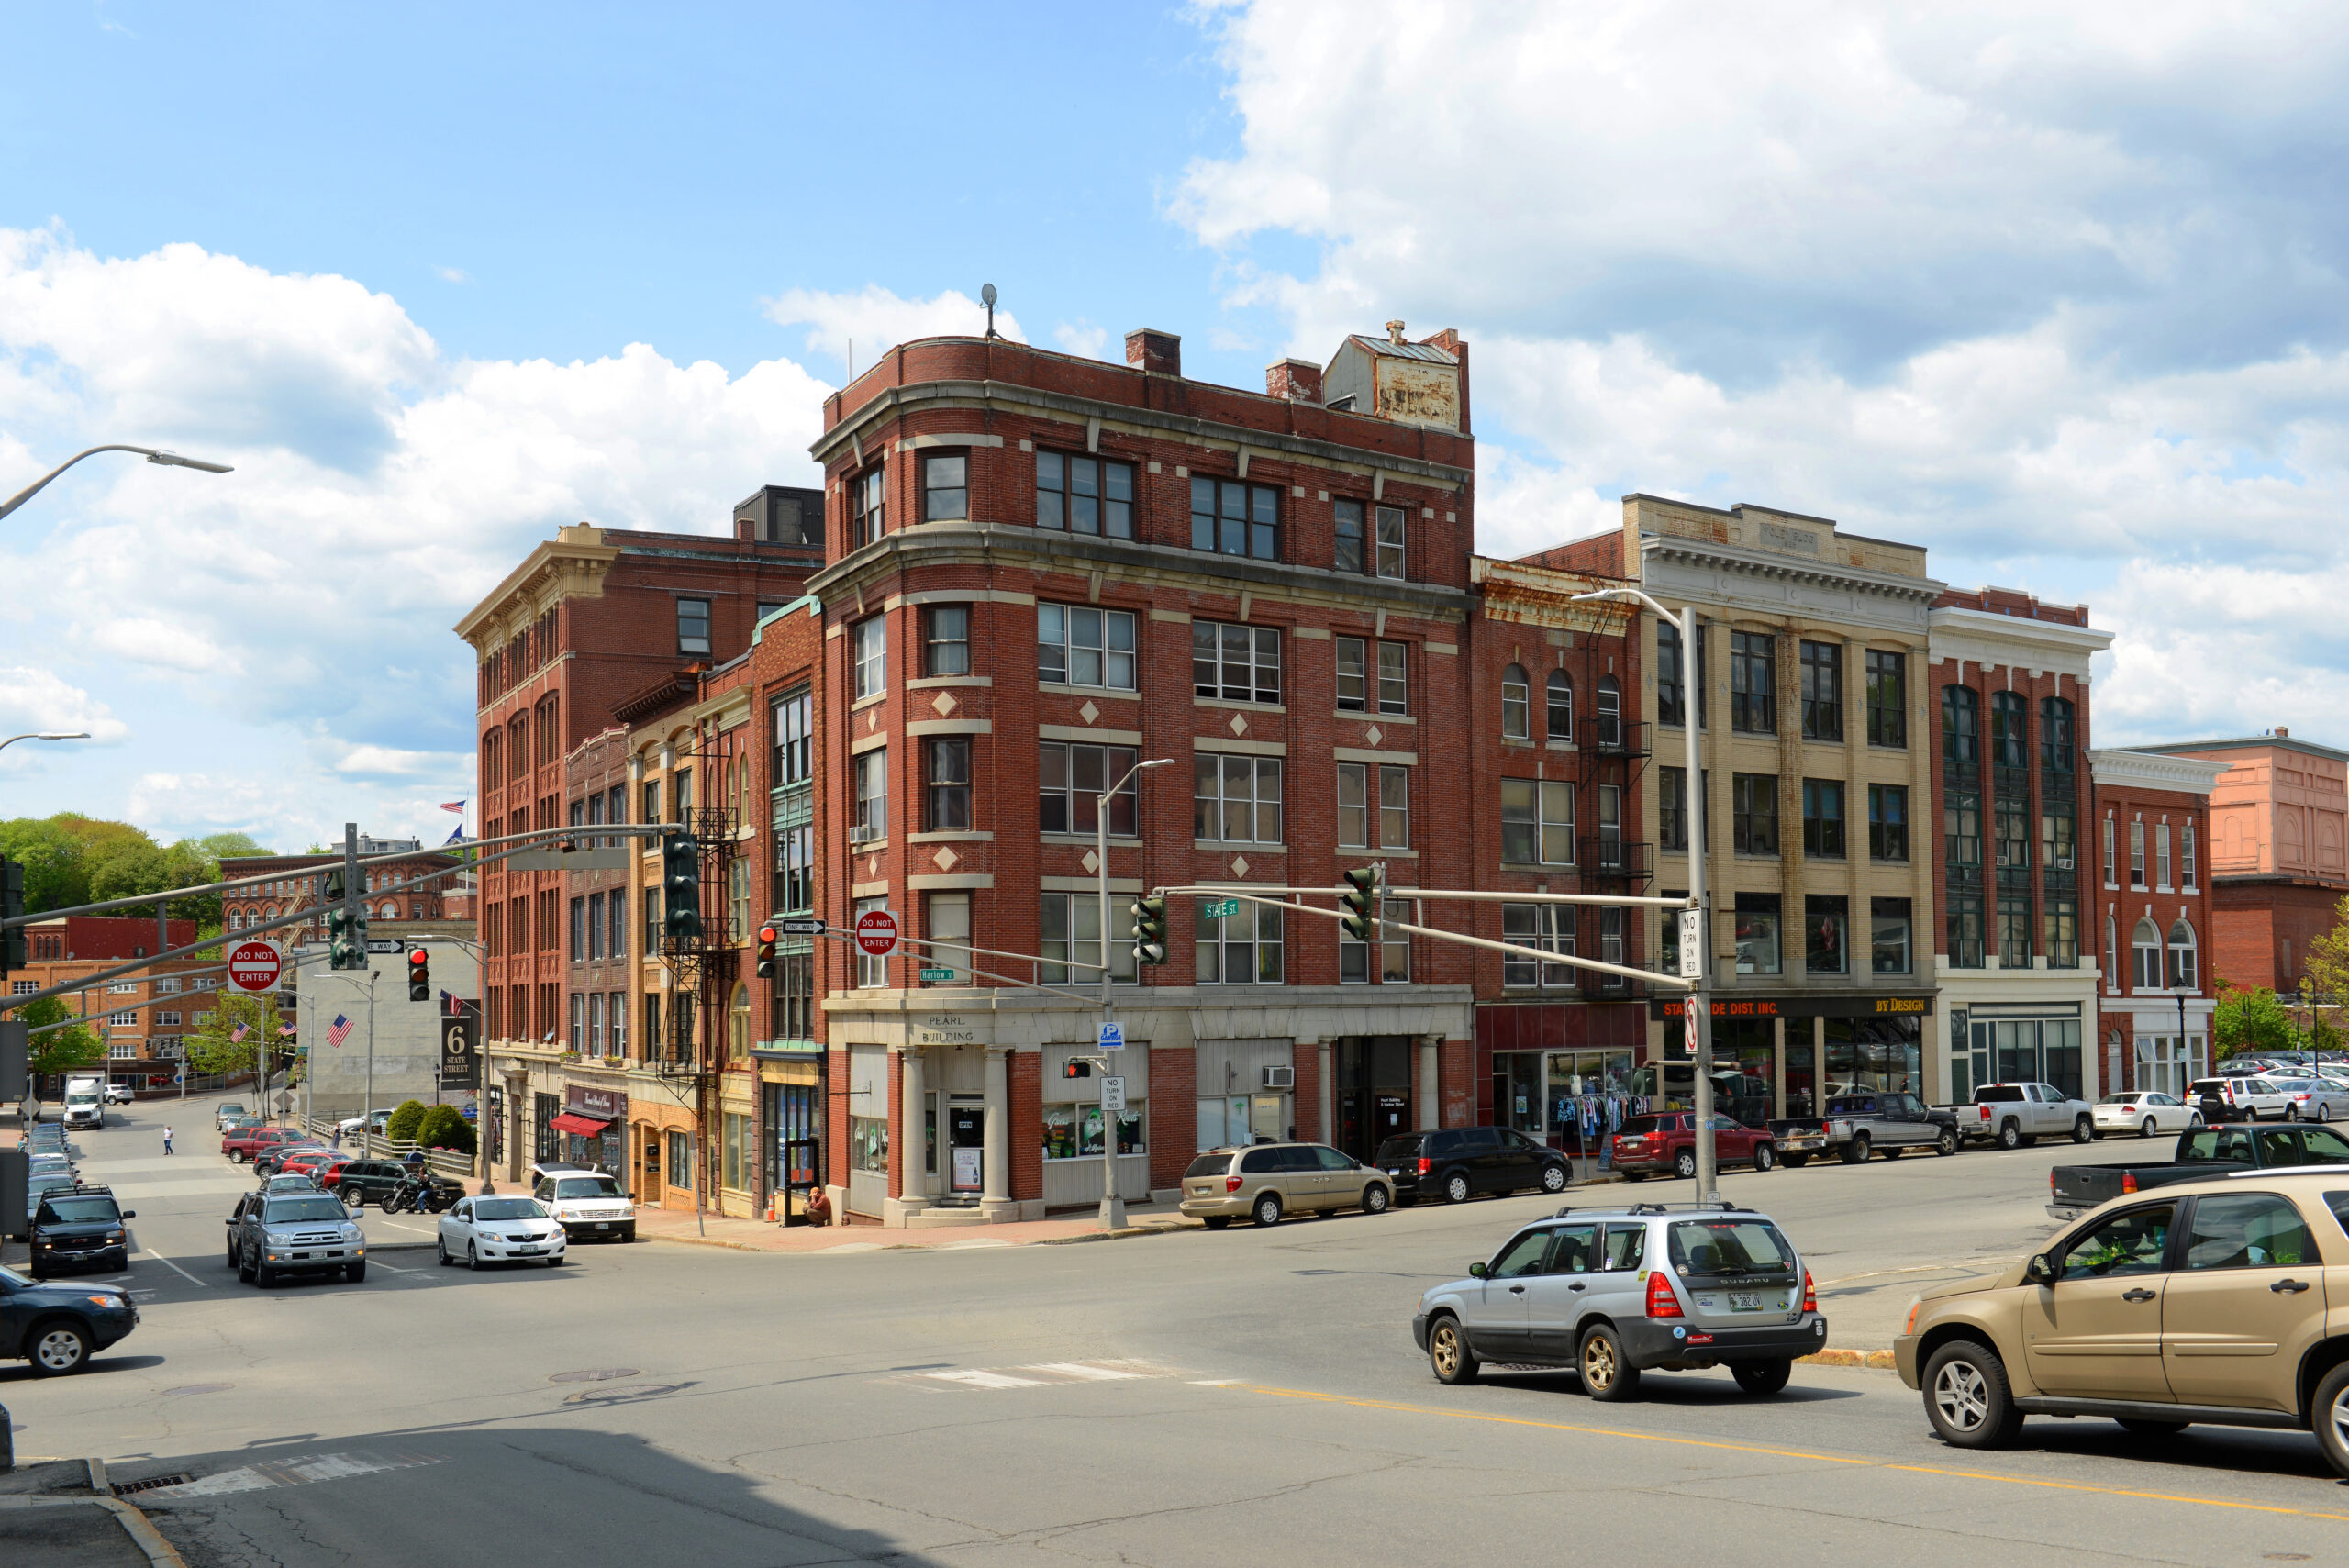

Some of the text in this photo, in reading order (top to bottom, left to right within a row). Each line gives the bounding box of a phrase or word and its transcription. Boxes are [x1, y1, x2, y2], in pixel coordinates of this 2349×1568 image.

[1207, 902, 1227, 917] STATE
[1684, 917, 1696, 929] NO
[864, 939, 890, 947] ENTER
[1683, 933, 1697, 944] TURN
[236, 951, 273, 960] DO NOT
[1686, 948, 1695, 958] ON
[1686, 962, 1696, 972] RED
[239, 973, 271, 982] ENTER
[922, 971, 945, 979] Harlow
[1730, 1002, 1755, 1015] DIST.
[1757, 1002, 1778, 1014] INC.
[1876, 1000, 1889, 1012] BY
[929, 1017, 965, 1026] PEARL
[447, 1025, 465, 1054] 6
[922, 1032, 973, 1042] BUILDING
[446, 1056, 466, 1064] STATE
[444, 1064, 469, 1073] STREET
